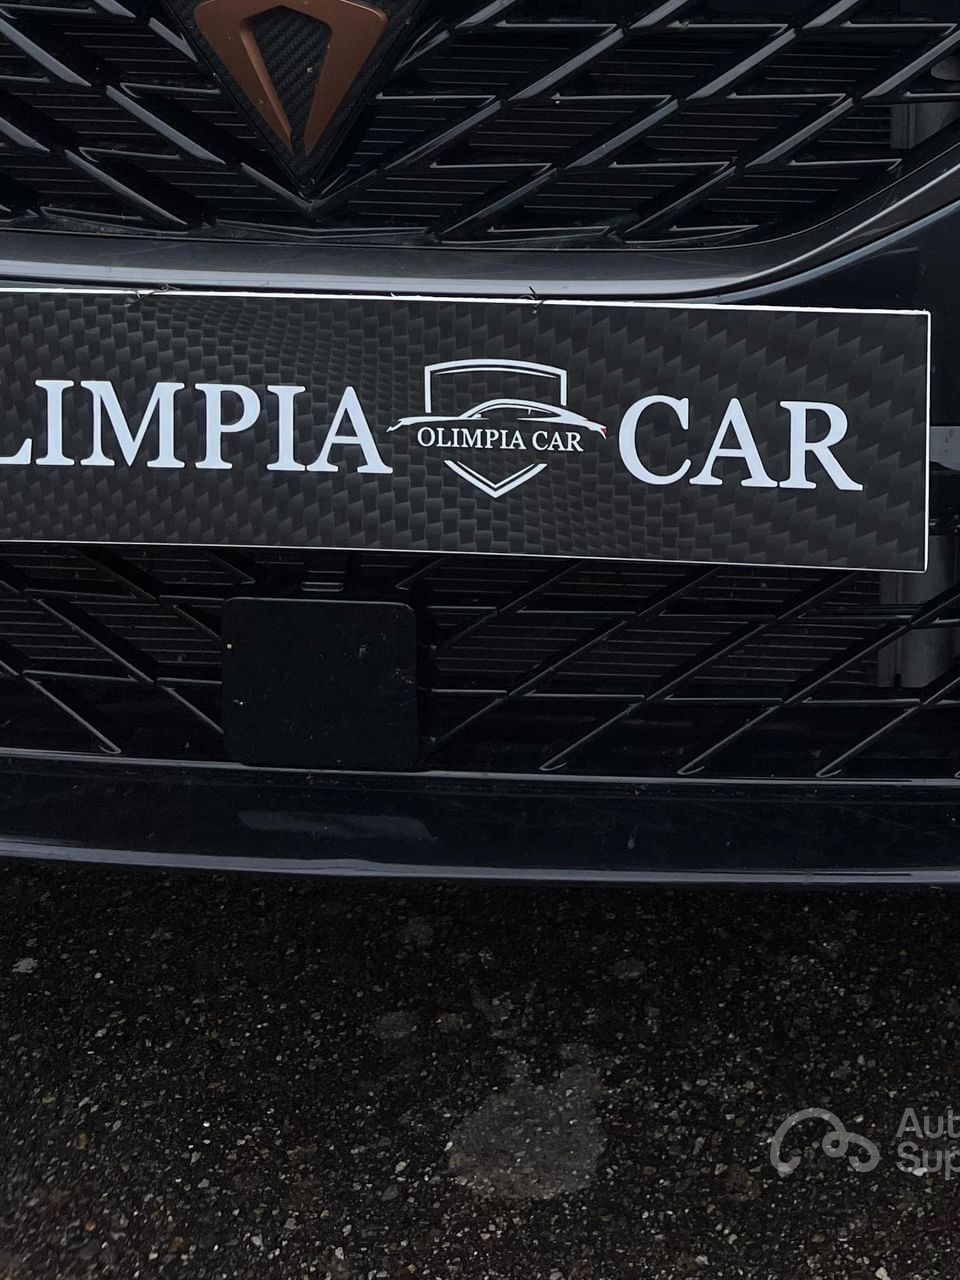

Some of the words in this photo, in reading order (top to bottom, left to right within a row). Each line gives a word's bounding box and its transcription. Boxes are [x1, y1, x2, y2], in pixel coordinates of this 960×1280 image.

[0, 379, 394, 474] IMPIA
[619, 394, 864, 492] CAR
[416, 426, 527, 451] OLIMPIA
[532, 429, 584, 452] CAR
